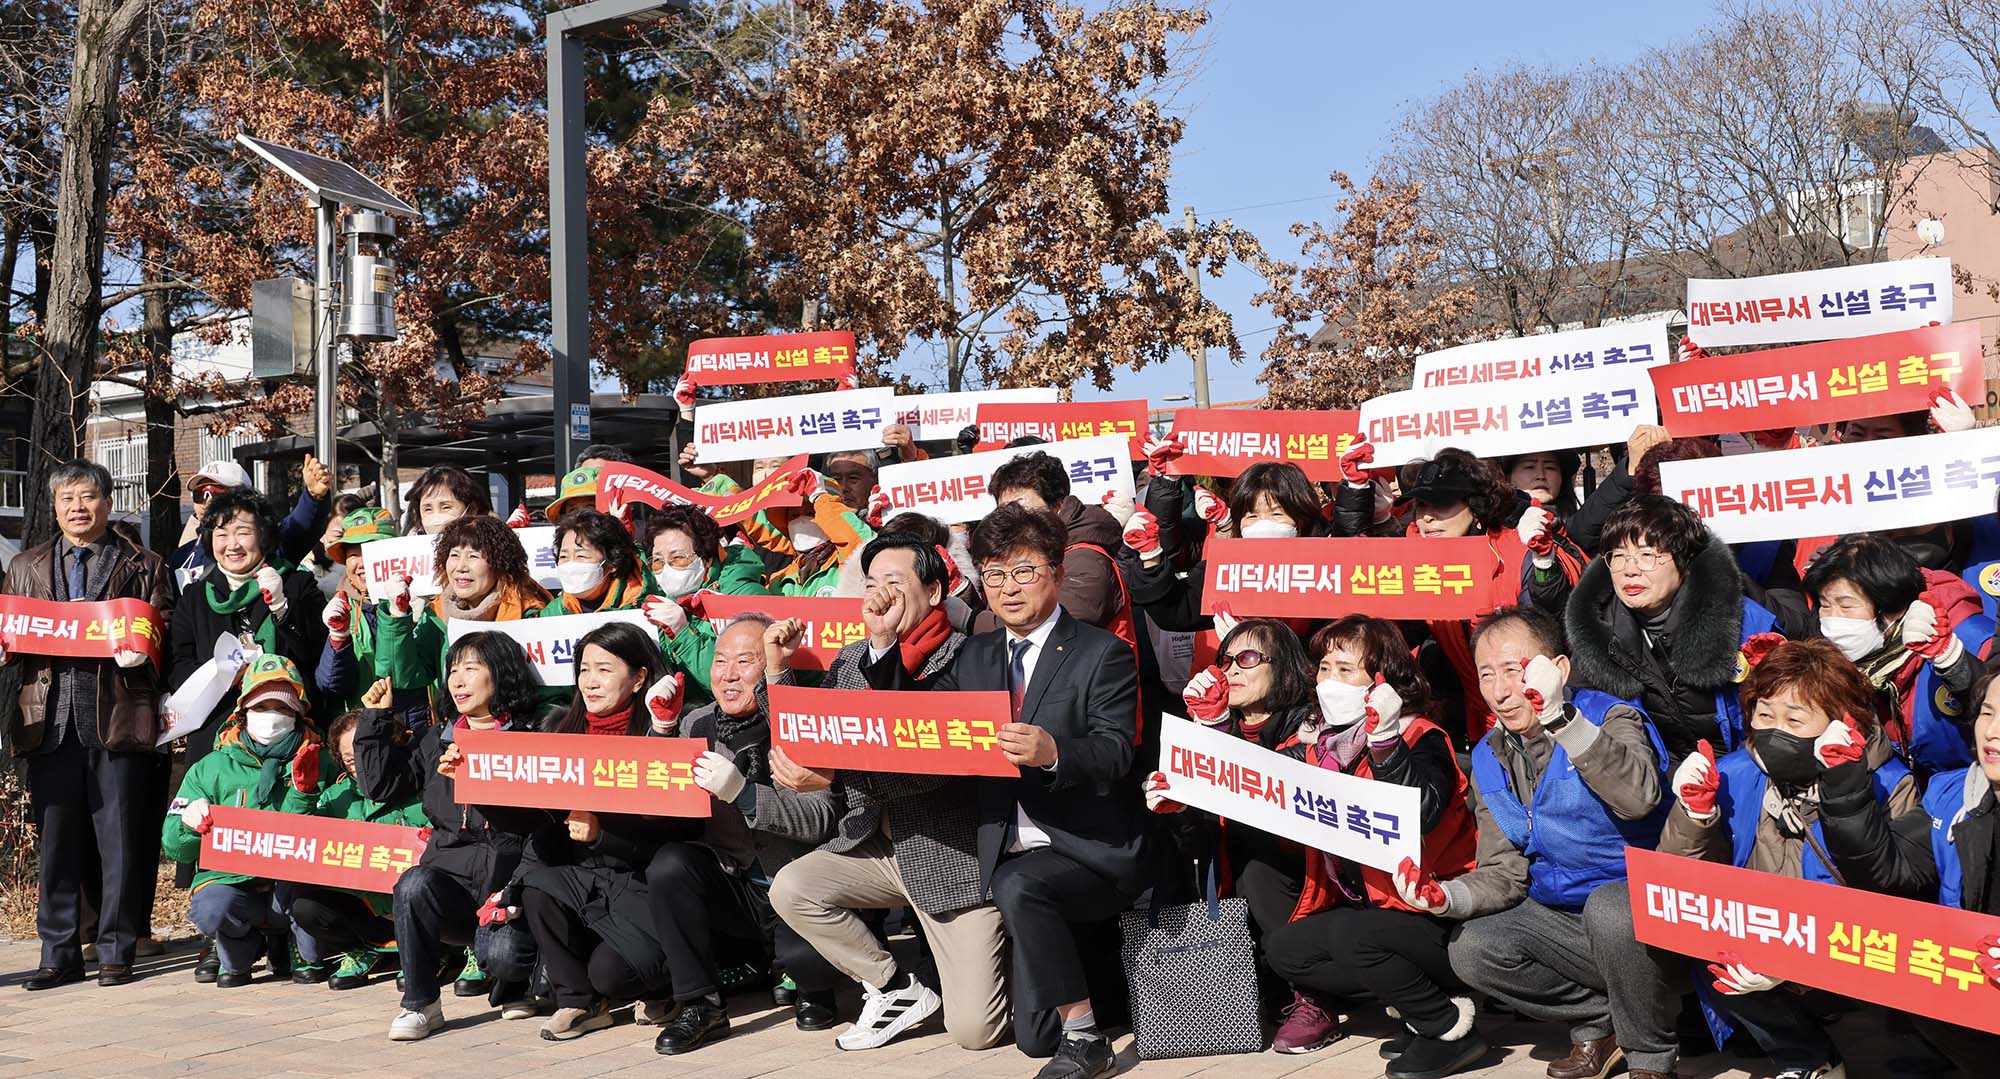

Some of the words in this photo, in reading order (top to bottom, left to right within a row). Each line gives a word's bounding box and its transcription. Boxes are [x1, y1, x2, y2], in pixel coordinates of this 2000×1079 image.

[1691, 296, 1811, 327] 대덕세무서
[1819, 289, 1870, 317] 신설
[1880, 283, 1937, 311] 촉구
[688, 351, 770, 373] 대덕세무서
[775, 348, 809, 368] 신설
[813, 346, 849, 365] 촉구
[1424, 358, 1541, 388] 대덕세무서
[1672, 371, 1818, 412] 대덕세무서
[1827, 362, 1889, 397] 신설
[1898, 352, 1962, 385] 촉구
[701, 415, 794, 445] 대덕세무서
[799, 411, 836, 436] 신설
[842, 408, 882, 430] 촉구
[1370, 405, 1508, 443] 대덕세무서
[1518, 397, 1573, 429] 신설
[1582, 388, 1639, 419] 촉구
[1178, 431, 1280, 458] 대덕세무서
[1286, 433, 1329, 460] 신설
[891, 475, 987, 509] 대덕세무
[1070, 456, 1118, 484] 촉구
[1681, 474, 1852, 518] 대덕세무서
[1864, 465, 1933, 502] 신설
[715, 495, 756, 518] 신설
[373, 554, 431, 583] 대덕세
[534, 546, 557, 569] 촉
[1215, 563, 1342, 594] 대덕세무서
[1349, 564, 1404, 595] 신설
[1413, 563, 1474, 596] 촉구
[0, 613, 78, 640] 세무서
[85, 616, 126, 640] 신설
[820, 621, 866, 649] 신설
[552, 639, 581, 664] 신
[778, 711, 889, 748] 대덕세무서
[893, 718, 942, 749] 신설
[946, 719, 999, 751] 촉구
[468, 752, 585, 786] 대덕세무서
[592, 758, 638, 788] 신설
[646, 760, 694, 792] 촉구
[1170, 744, 1286, 810] 대덕세무서
[1293, 787, 1339, 829] 신설
[1346, 804, 1401, 846] 촉구
[212, 827, 316, 862] 대덕세무서
[322, 840, 364, 868] 신설
[369, 846, 413, 874] 촉구
[1646, 882, 1816, 954] 대덕세무서
[1827, 921, 1897, 974] 신설
[1909, 938, 1985, 991] 촉구
